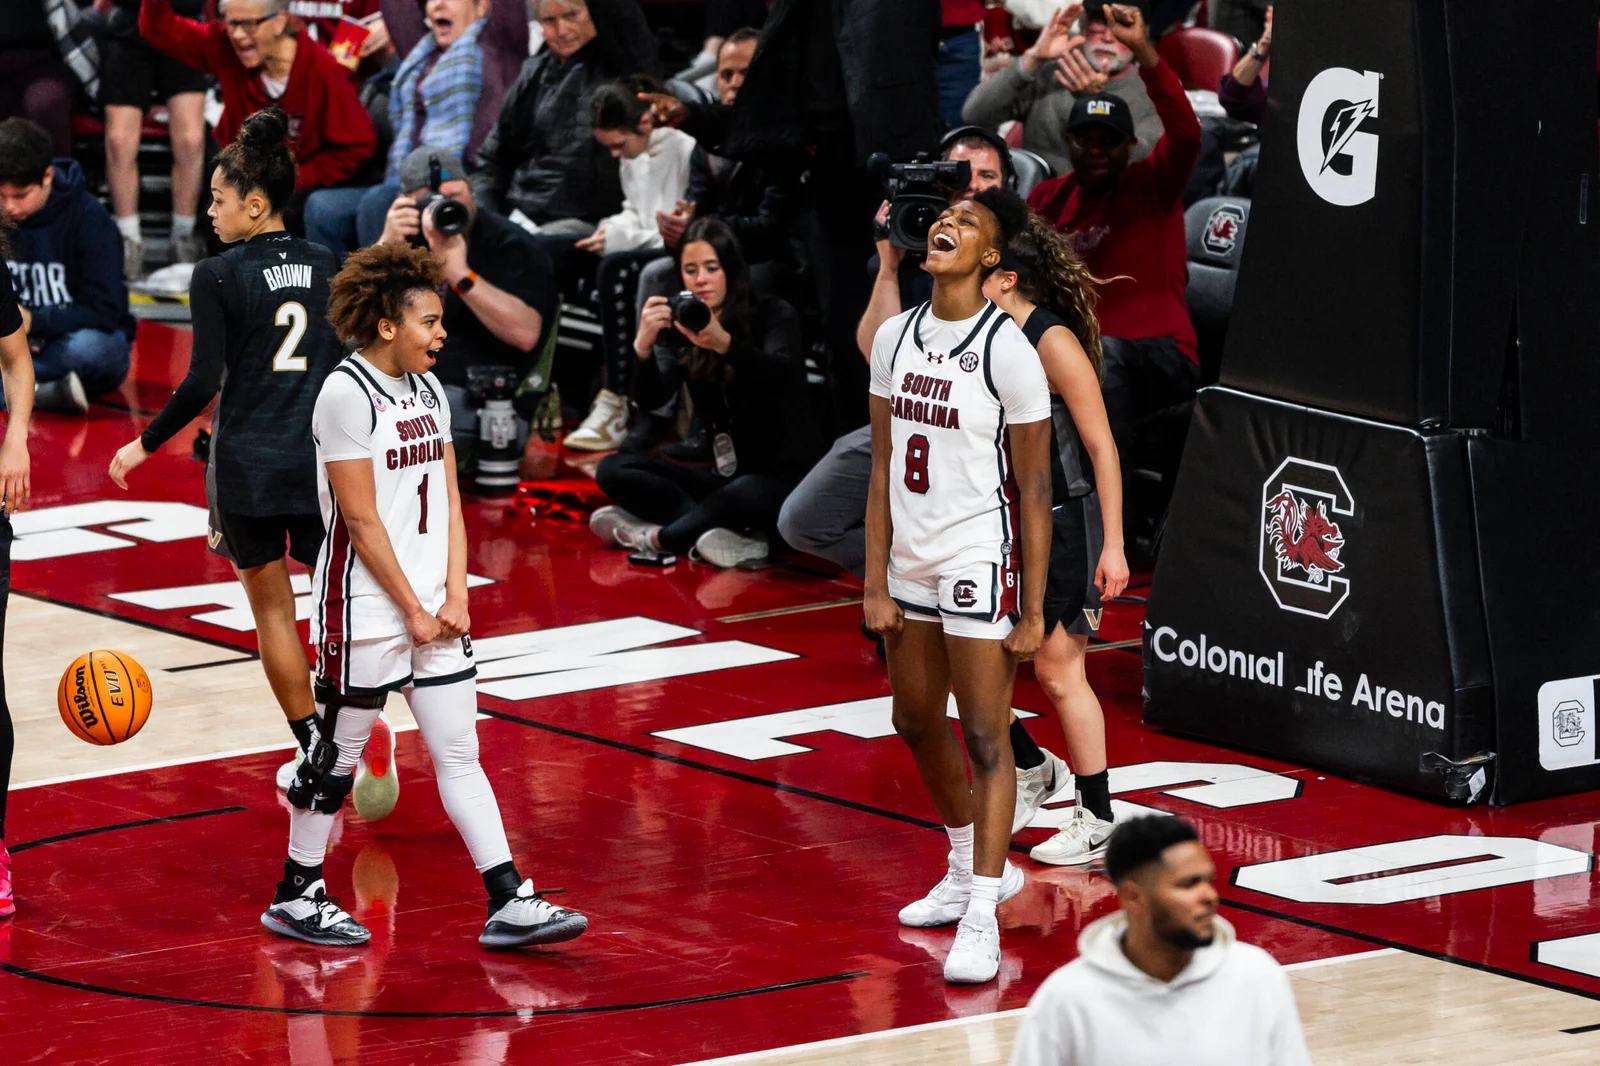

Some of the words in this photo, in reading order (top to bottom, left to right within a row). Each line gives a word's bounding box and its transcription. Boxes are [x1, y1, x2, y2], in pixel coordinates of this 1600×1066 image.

[1086, 100, 1112, 115] CAT
[262, 263, 313, 291] BROWN
[272, 300, 308, 372] 2
[901, 372, 953, 402] SOUTH
[396, 413, 439, 442] SOUTH
[386, 437, 445, 470] CAROLIN
[904, 433, 930, 494] 8
[417, 473, 428, 535] 1
[1005, 571, 1015, 588] B
[1152, 625, 1284, 687] Colonial
[1294, 660, 1343, 701] ife
[1351, 672, 1446, 730] Arena
[73, 664, 99, 729] Wilson
